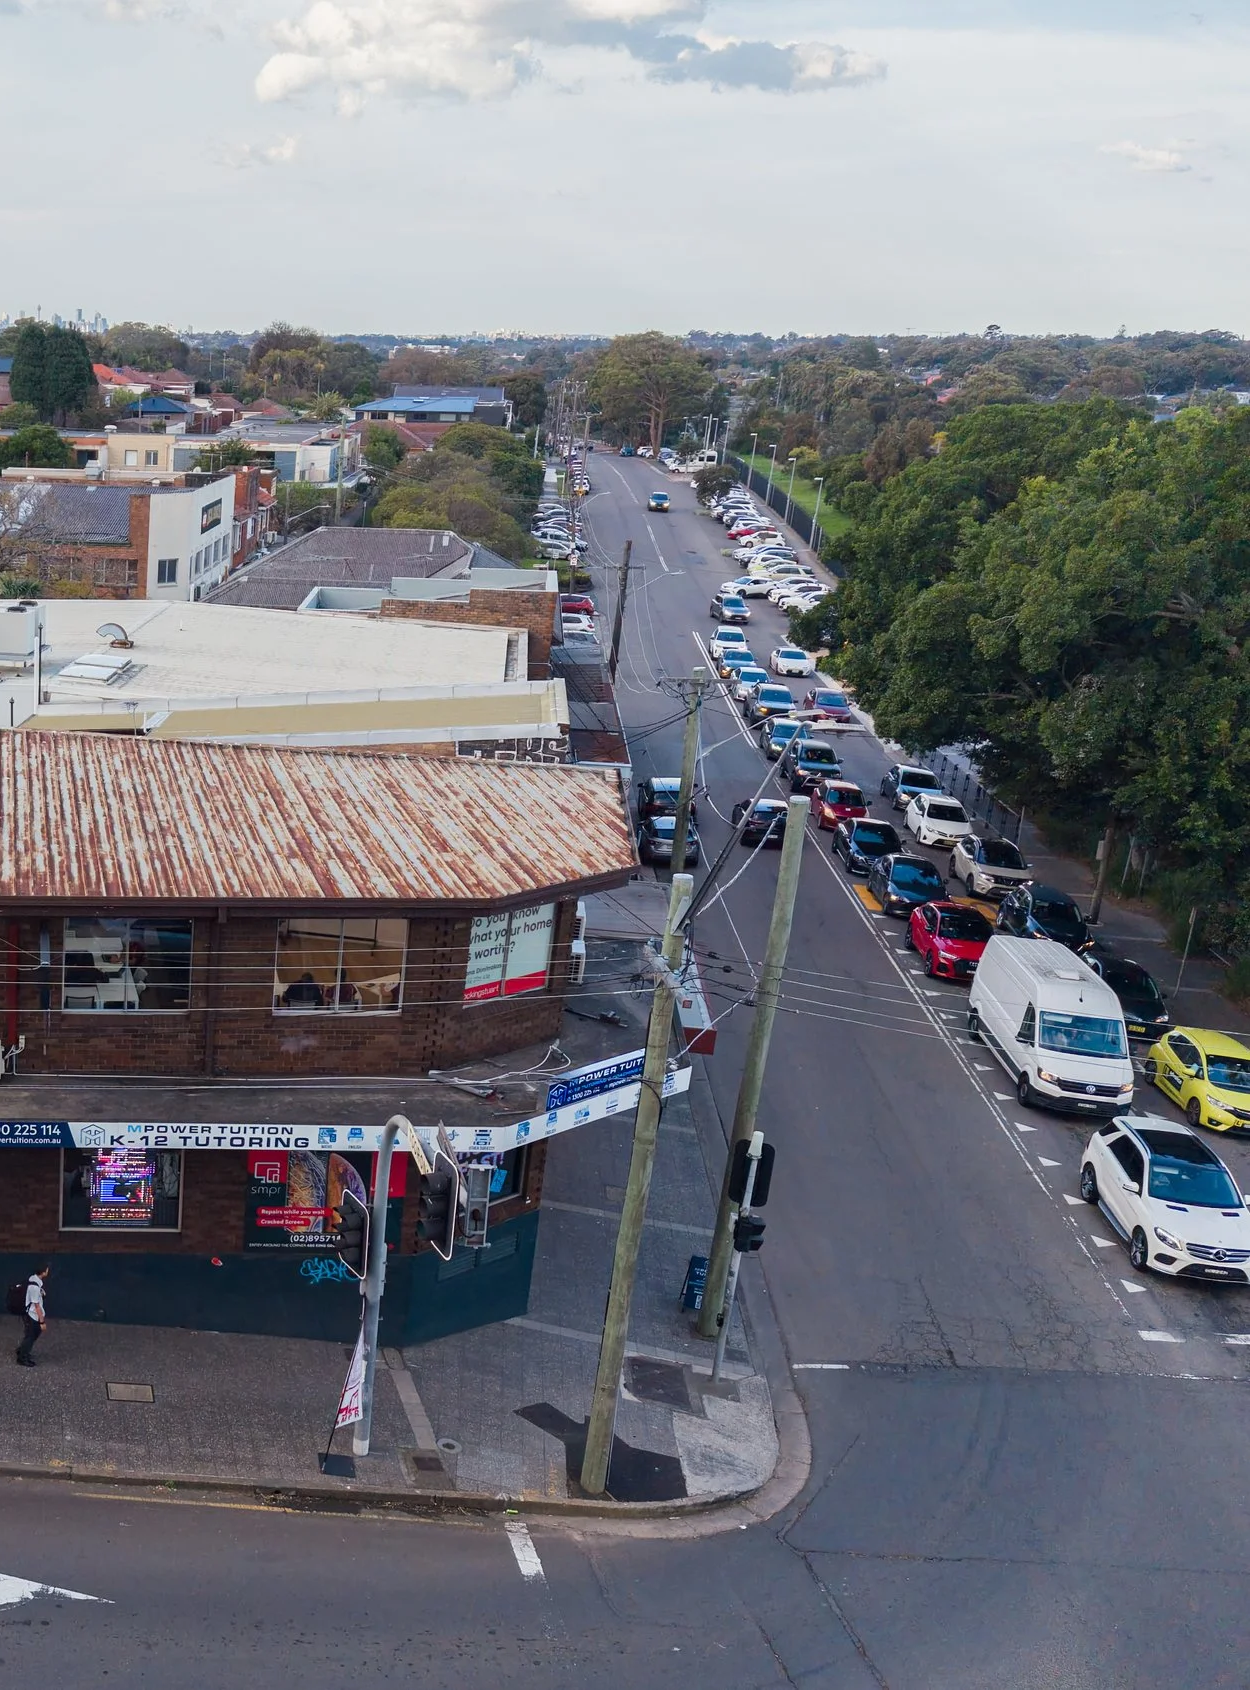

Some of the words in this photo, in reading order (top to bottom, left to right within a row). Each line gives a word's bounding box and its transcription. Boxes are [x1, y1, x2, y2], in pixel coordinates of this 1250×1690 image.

[487, 913, 506, 928] you
[523, 918, 552, 934] home
[14, 1124, 37, 1136] 225
[42, 1124, 61, 1136] 114
[128, 1125, 211, 1134] MPOWER
[218, 1126, 293, 1135] TUITION
[111, 1135, 168, 1146] K-12
[179, 1136, 309, 1148] TUTORING
[251, 1185, 281, 1197] smpr
